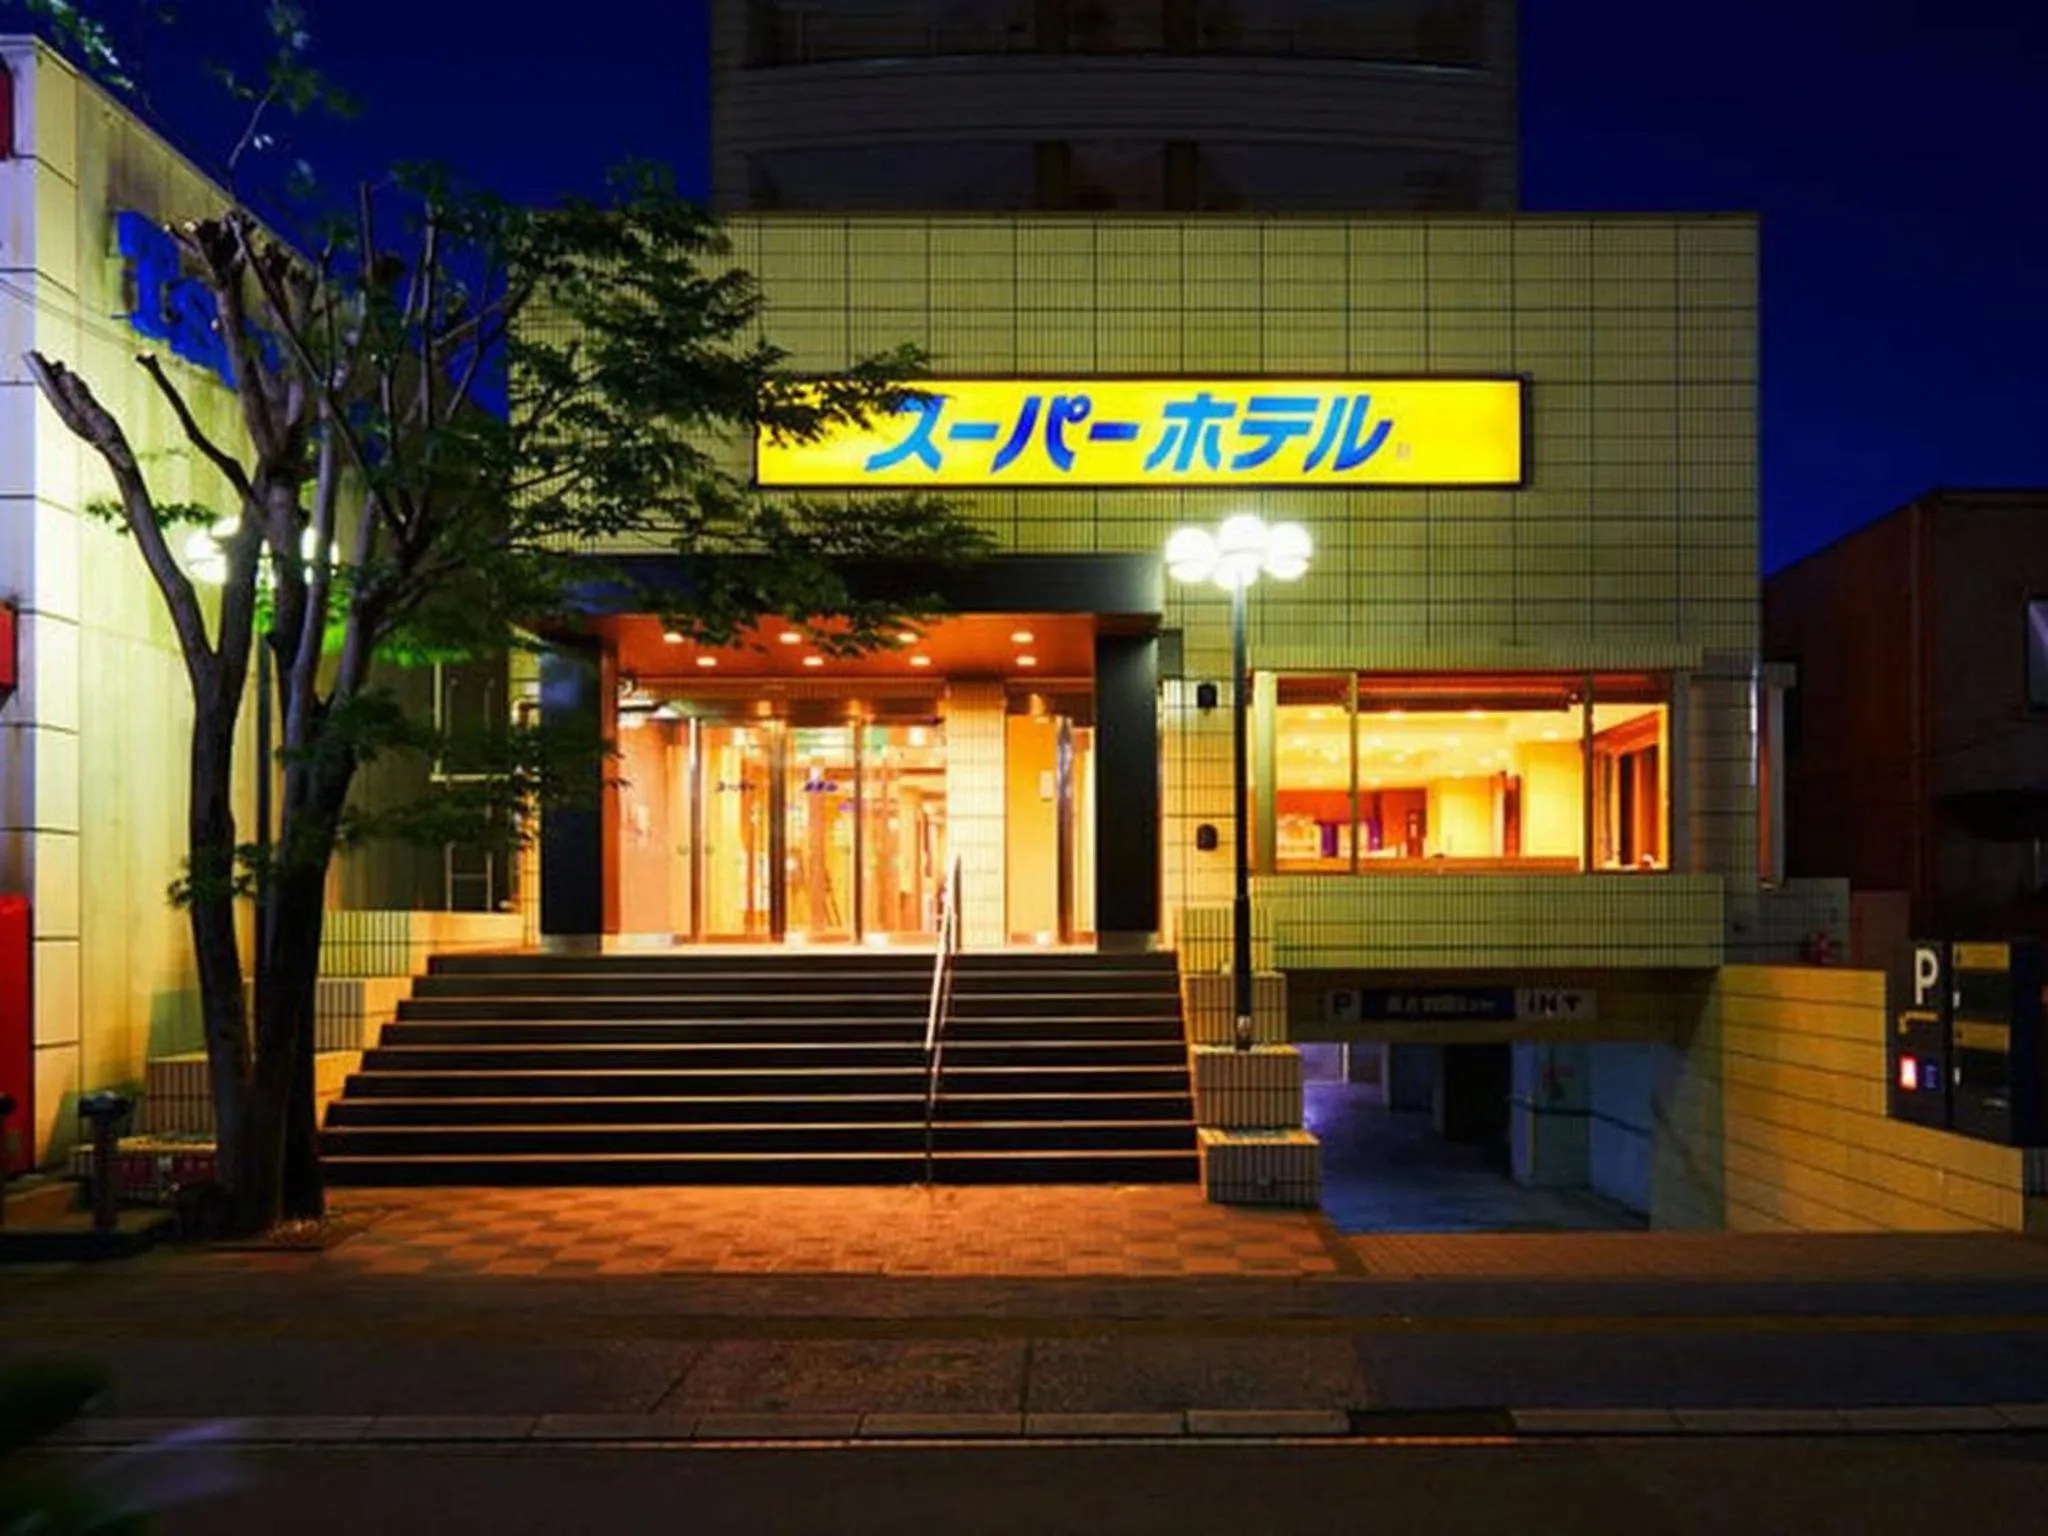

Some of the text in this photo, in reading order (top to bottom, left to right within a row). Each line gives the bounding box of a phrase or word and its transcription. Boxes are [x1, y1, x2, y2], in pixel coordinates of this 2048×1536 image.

[866, 395, 1392, 471] スーパーホテル
[1915, 948, 1938, 1005] P
[1333, 992, 1351, 1014] P
[1528, 993, 1558, 1012] IN
